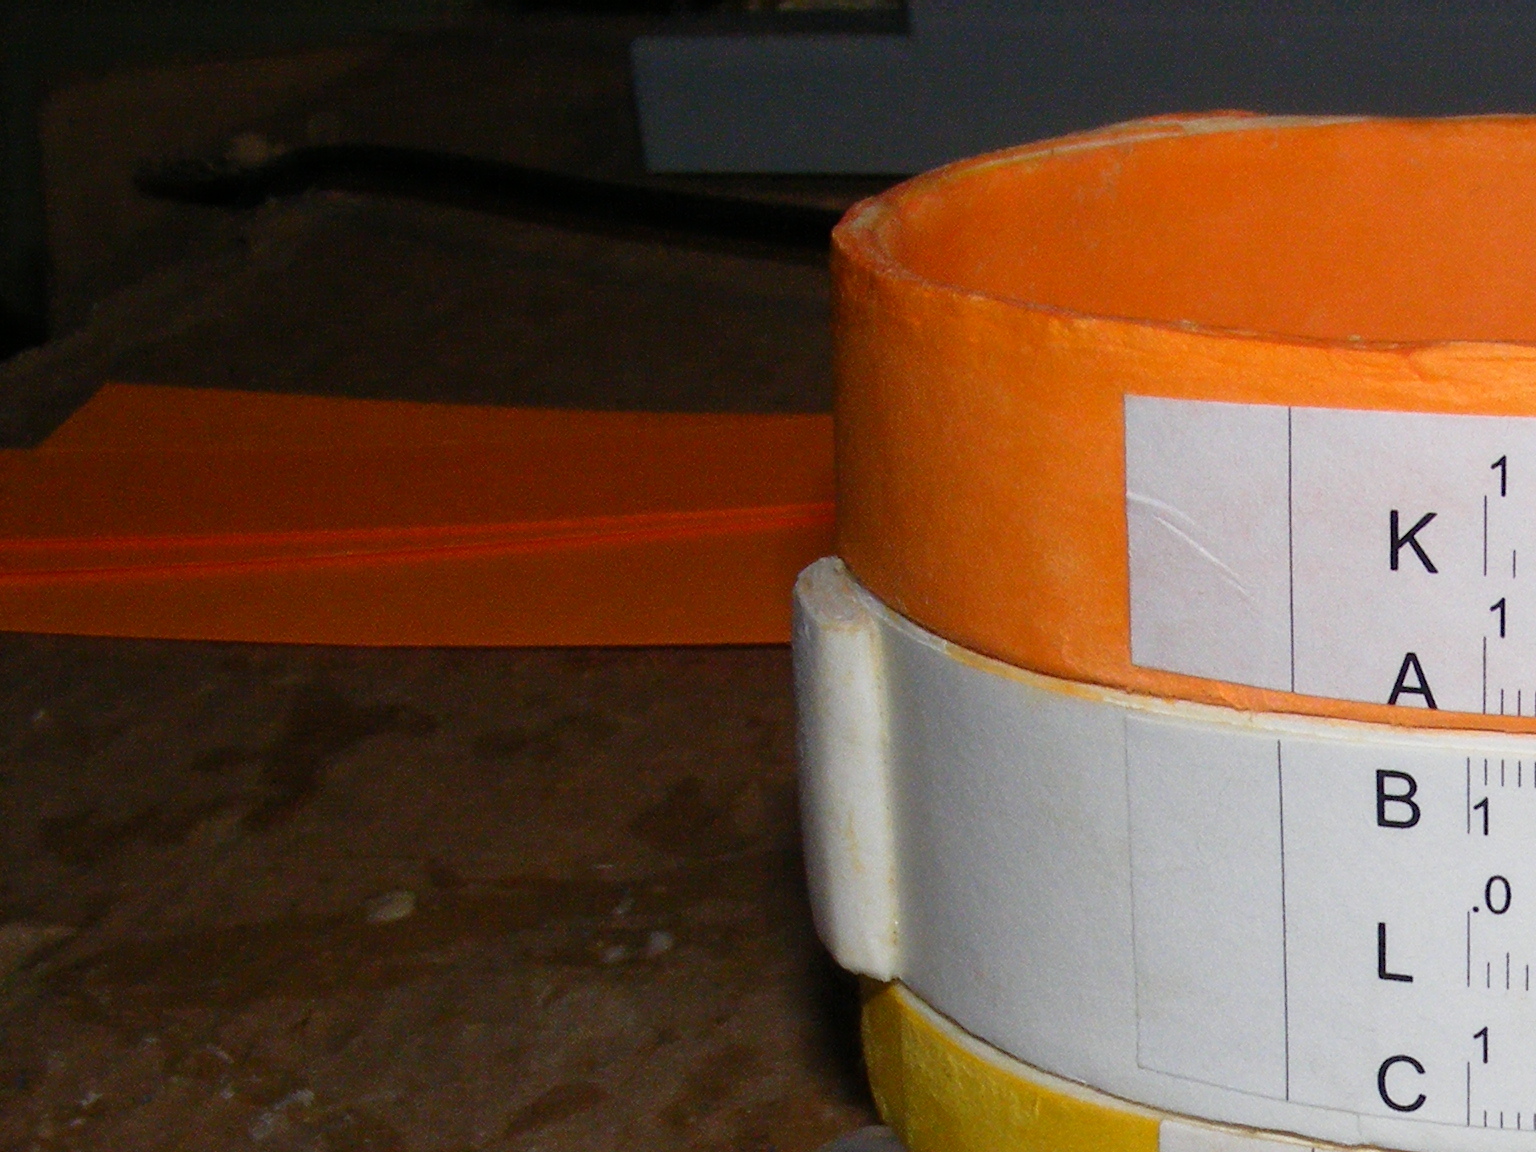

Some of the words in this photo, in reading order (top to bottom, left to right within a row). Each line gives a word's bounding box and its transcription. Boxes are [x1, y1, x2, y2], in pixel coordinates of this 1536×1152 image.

[1388, 509, 1439, 575] K
[1490, 455, 1507, 497] 1
[1387, 652, 1439, 710] A
[1489, 597, 1506, 638] 1
[1374, 769, 1422, 830] B
[1473, 796, 1490, 837] 1
[1376, 921, 1414, 983] L
[1376, 1054, 1428, 1113] C
[1472, 1026, 1489, 1064] 1
